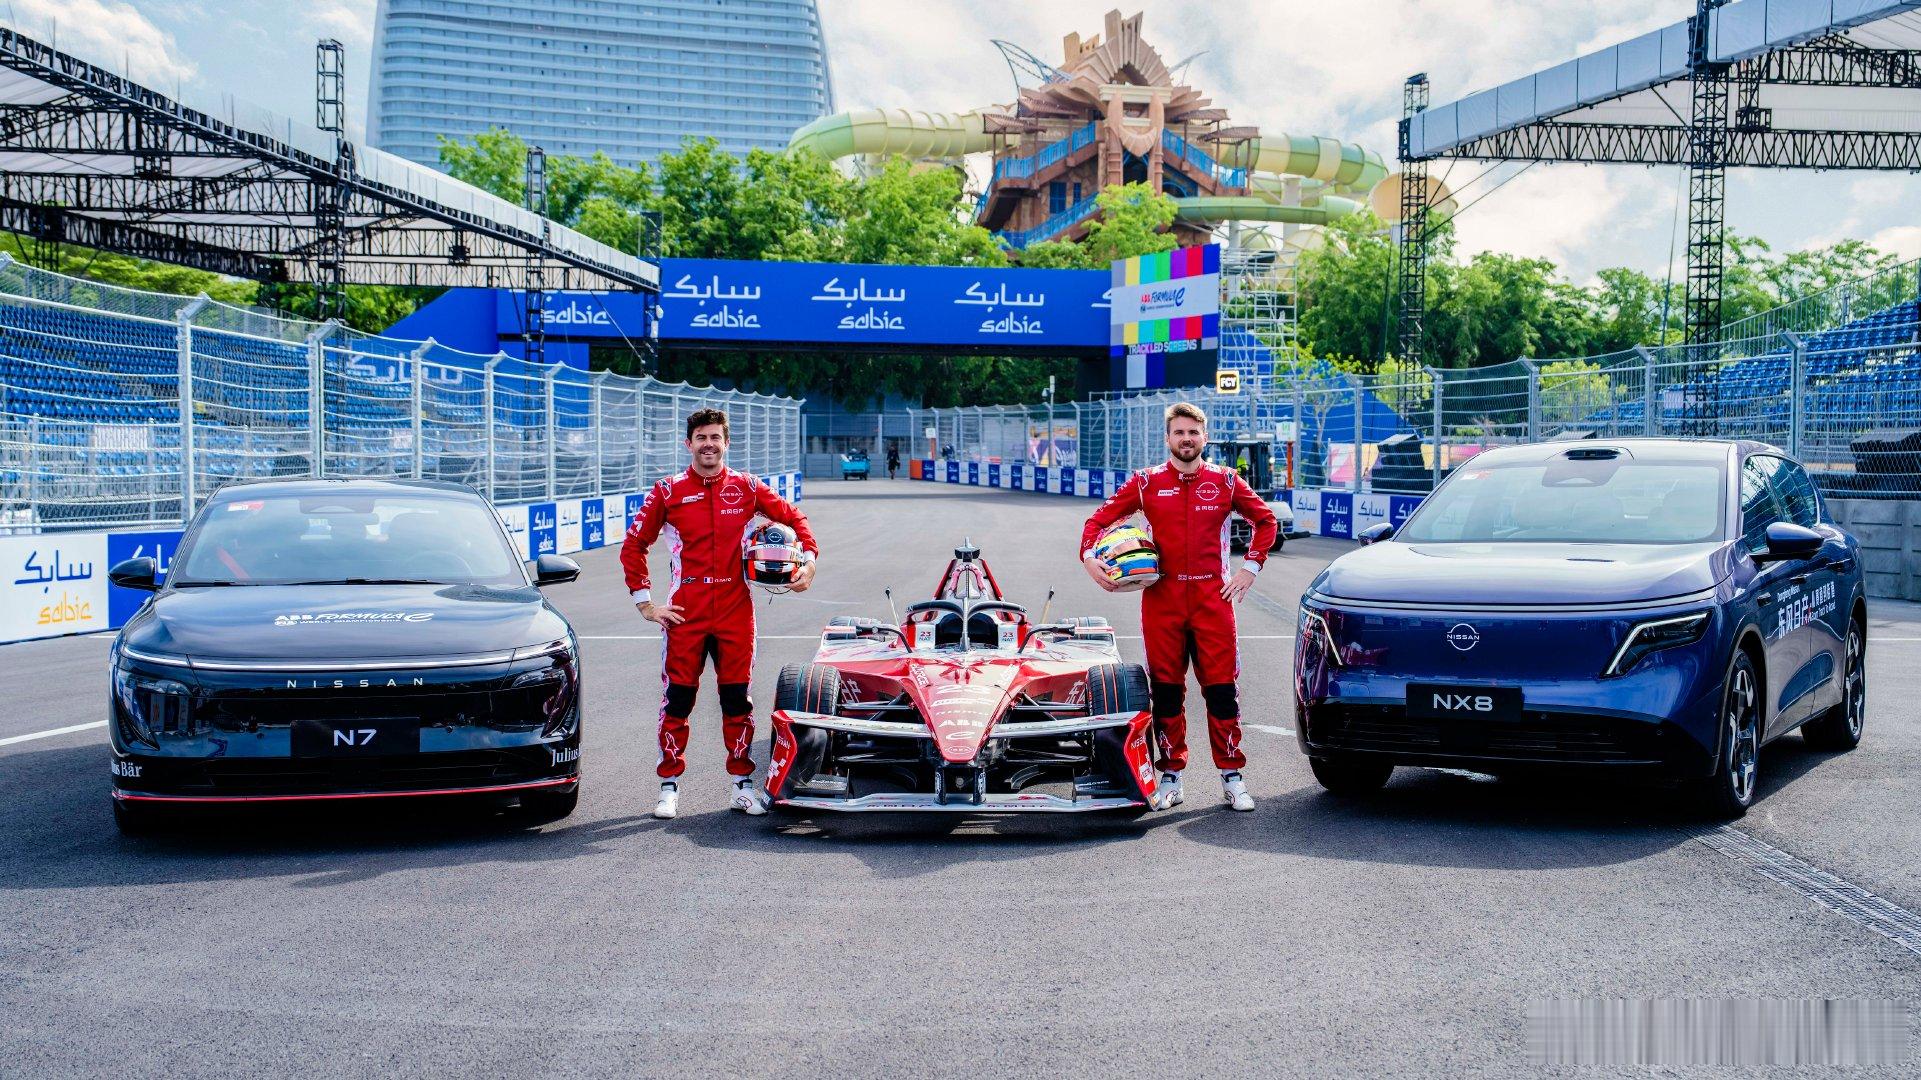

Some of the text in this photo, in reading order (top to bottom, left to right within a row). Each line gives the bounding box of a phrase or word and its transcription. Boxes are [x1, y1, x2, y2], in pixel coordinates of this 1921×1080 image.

[690, 305, 761, 328] sabic
[837, 307, 906, 330] sabic
[978, 311, 1044, 334] sabic
[1129, 339, 1198, 355] TRACK LED SCREENS
[314, 612, 405, 621] FORMULA
[286, 677, 424, 689] NISSAN
[1433, 693, 1493, 712] NX8
[333, 728, 377, 746] N7
[551, 747, 579, 767] Julius
[121, 761, 143, 778] Bär
